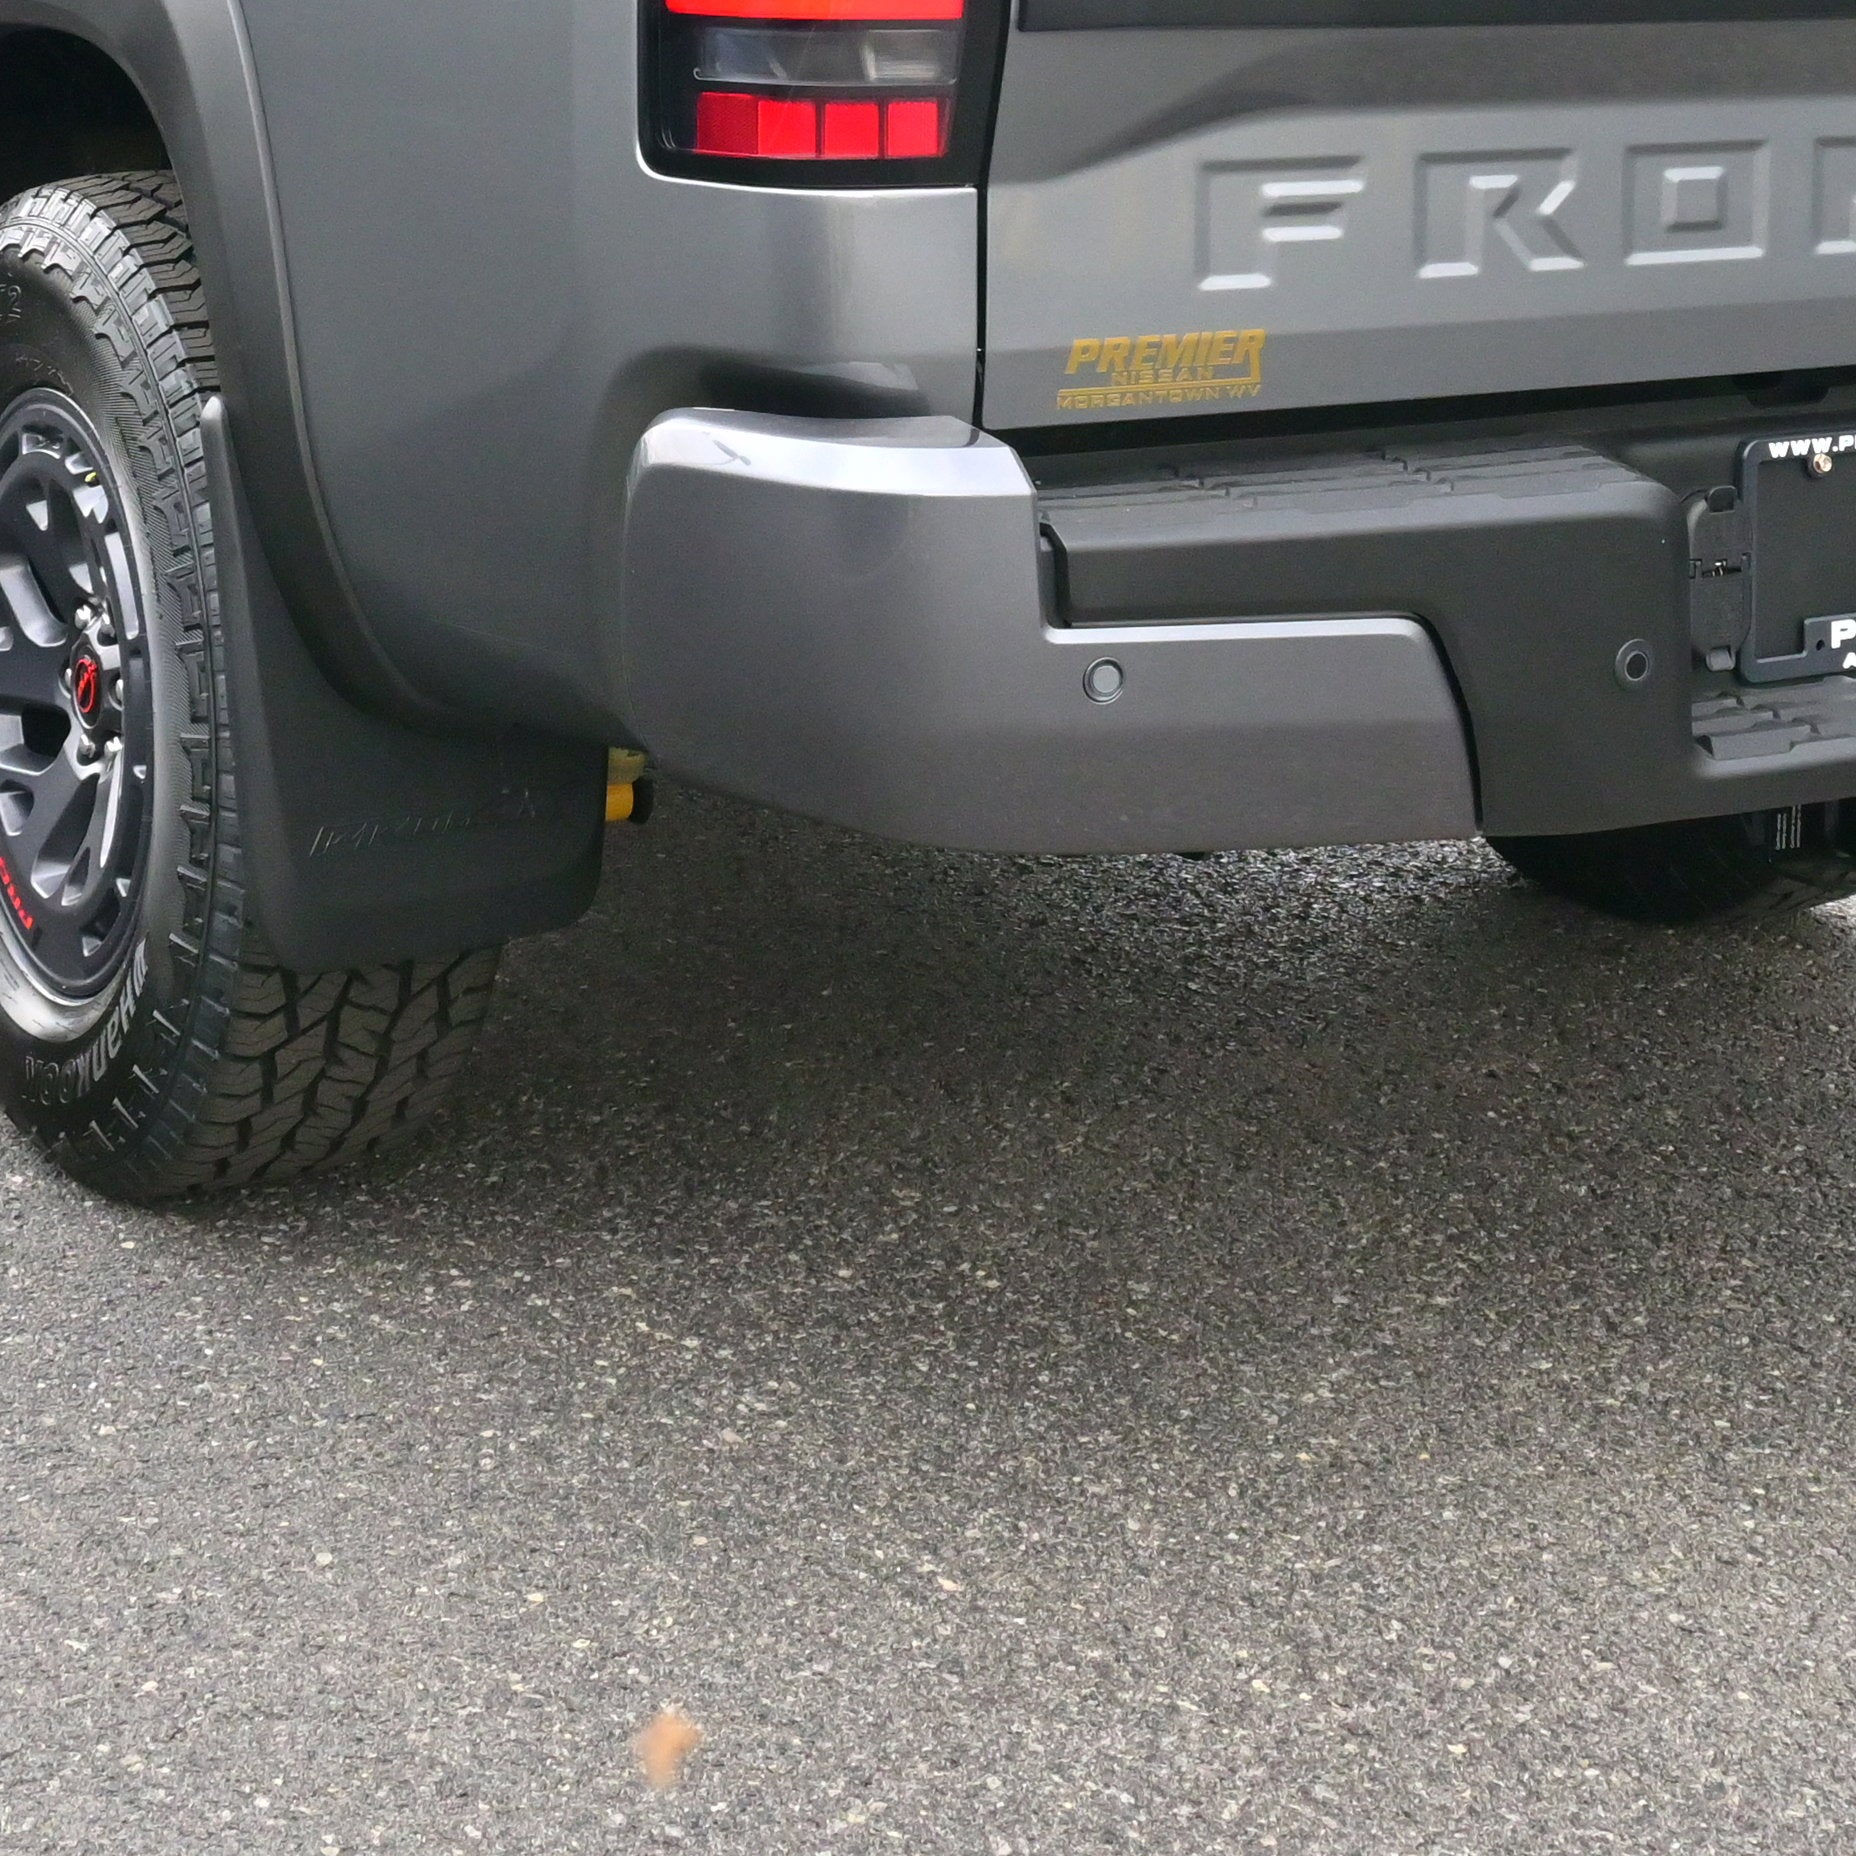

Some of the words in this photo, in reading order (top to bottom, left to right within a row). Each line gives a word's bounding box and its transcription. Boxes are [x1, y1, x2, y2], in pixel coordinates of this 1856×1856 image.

[1064, 328, 1266, 375] PREMIER
[1111, 366, 1214, 386] NISSAN
[1057, 388, 1220, 410] MORGANTOWN
[1226, 384, 1262, 400] WV
